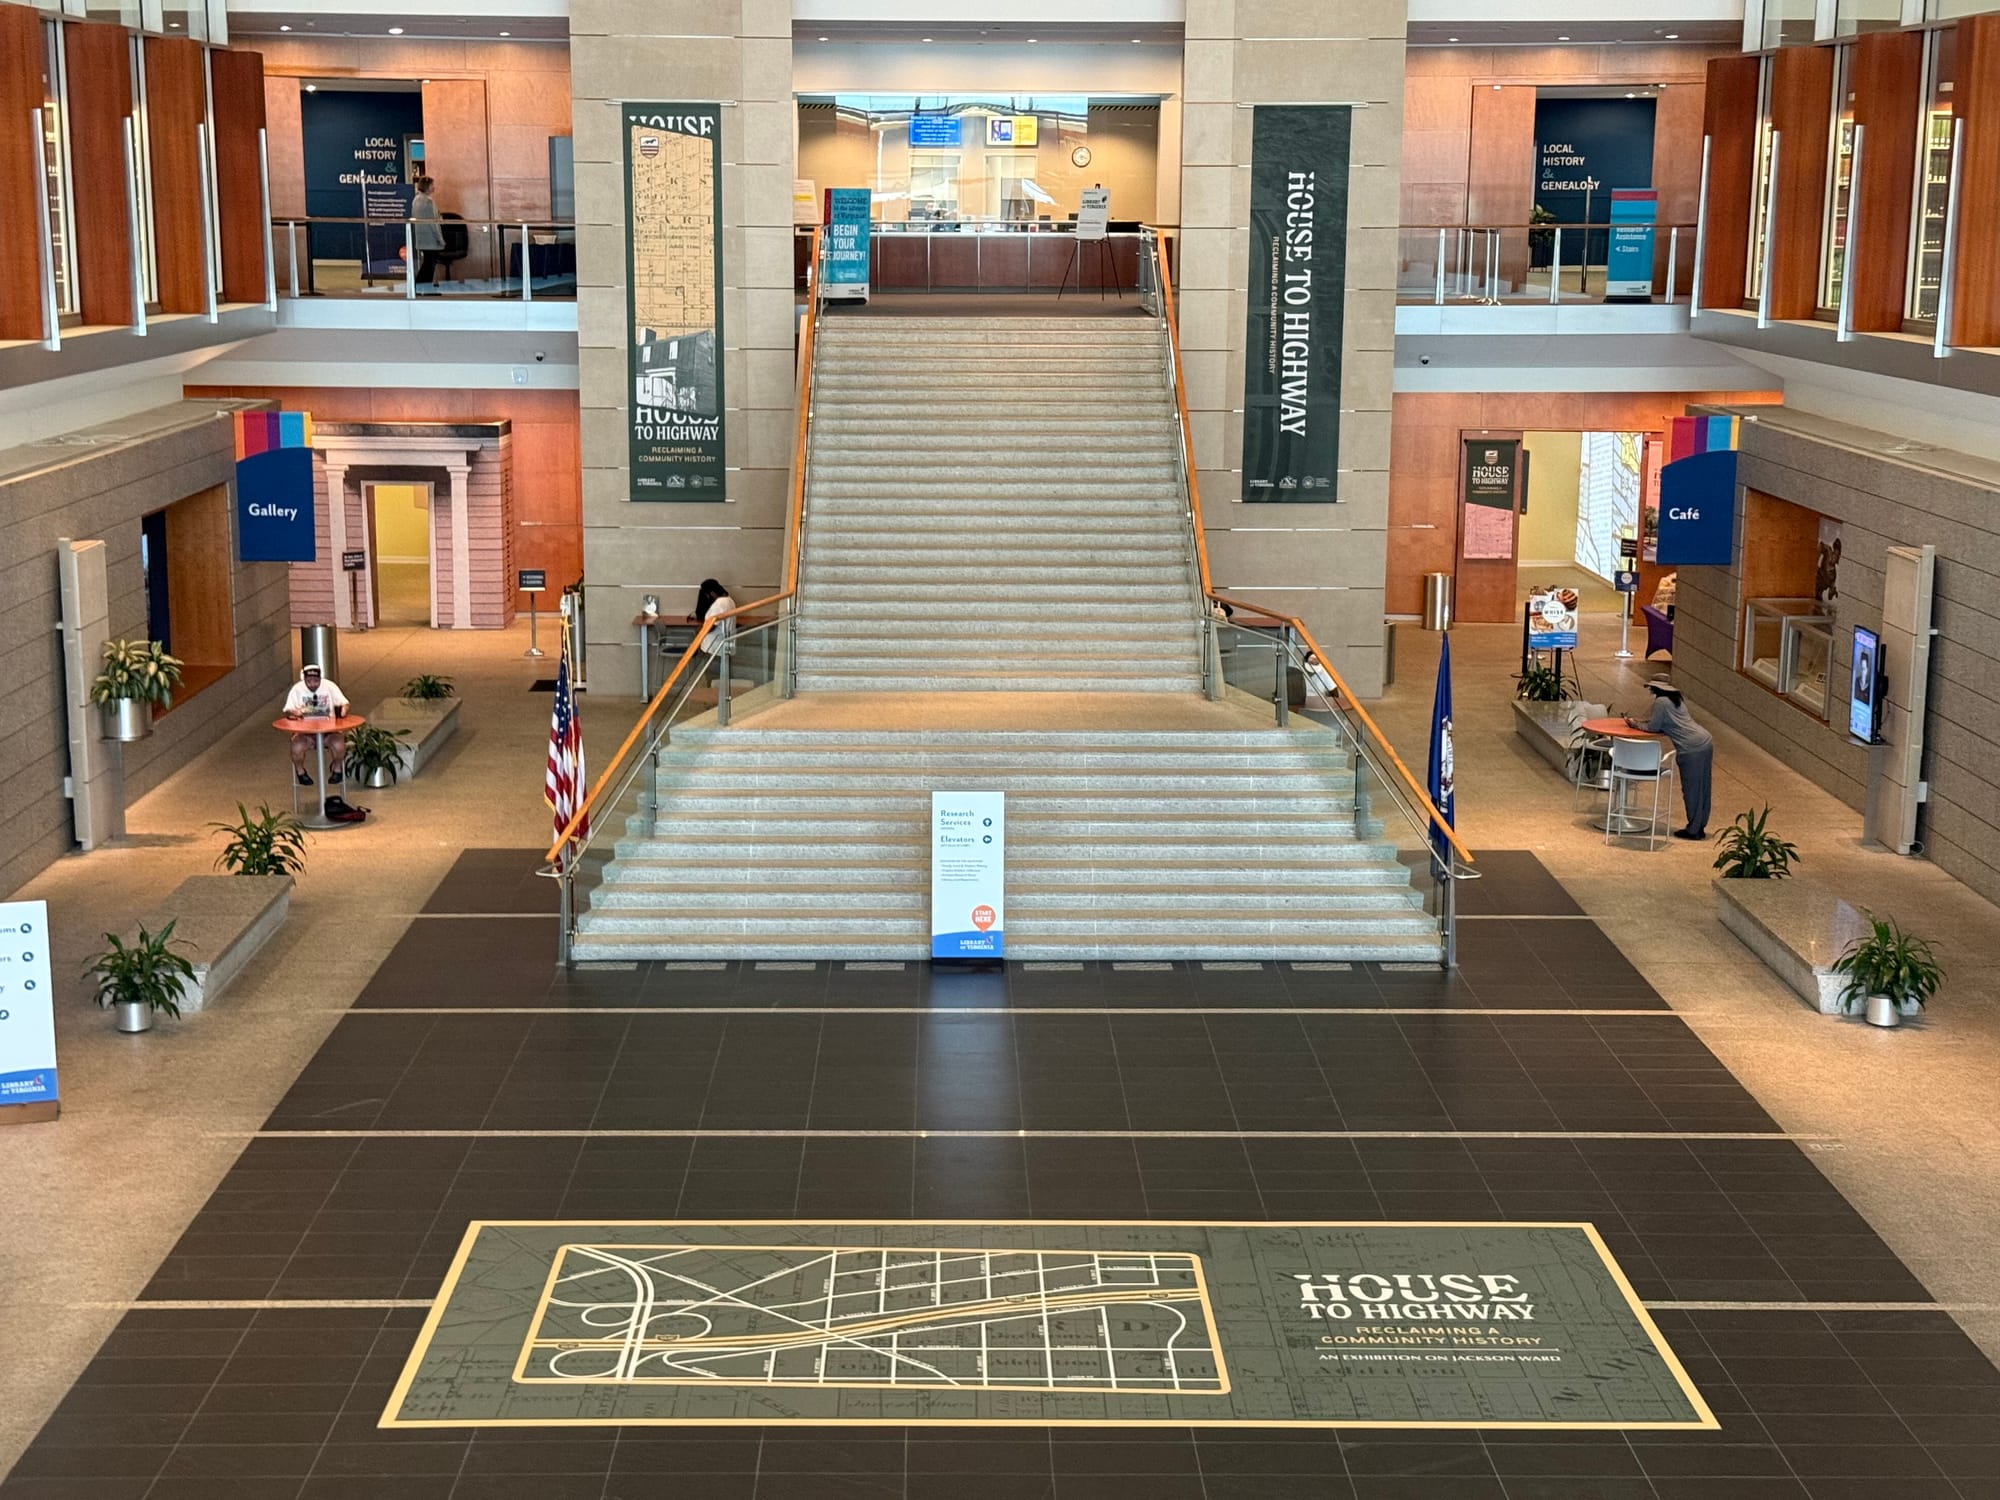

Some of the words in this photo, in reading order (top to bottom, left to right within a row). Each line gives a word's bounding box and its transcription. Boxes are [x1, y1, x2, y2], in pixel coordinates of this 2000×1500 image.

[365, 137, 396, 148] LOCAL
[1543, 144, 1574, 154] LOCAL
[354, 150, 396, 160] HISTORY
[1543, 157, 1585, 166] HISTORY
[385, 162, 397, 173] &
[1542, 168, 1555, 179] &
[1285, 171, 1315, 262] HOUSE
[833, 224, 858, 236] BEGIN
[1616, 233, 1646, 241] Assistance
[833, 238, 855, 249] YOUR
[833, 251, 866, 261] JOURNEY!
[1271, 236, 1280, 283] RECLAIMING
[1284, 268, 1312, 305] TO
[1269, 292, 1278, 339] COMMUNITY
[1268, 340, 1277, 374] HISTORY
[1280, 312, 1310, 437] HIGHWAY
[634, 426, 653, 440] TO
[656, 426, 719, 440] HIGHWAY
[638, 455, 682, 463] COMMUNITY
[1472, 466, 1509, 477] HOUSE
[248, 503, 298, 521] Gallery
[1669, 508, 1700, 520] Café
[940, 809, 974, 817] Research
[940, 835, 975, 843] Elevators
[1294, 1273, 1528, 1302] HOUSE
[1301, 1303, 1352, 1319] TO
[1359, 1303, 1535, 1320] HIGHWAY
[1356, 1326, 1483, 1335] RECLAIMING
[1488, 1326, 1500, 1335] A
[1321, 1336, 1447, 1345] COMMUNITY
[1452, 1336, 1543, 1345] HISTORY
